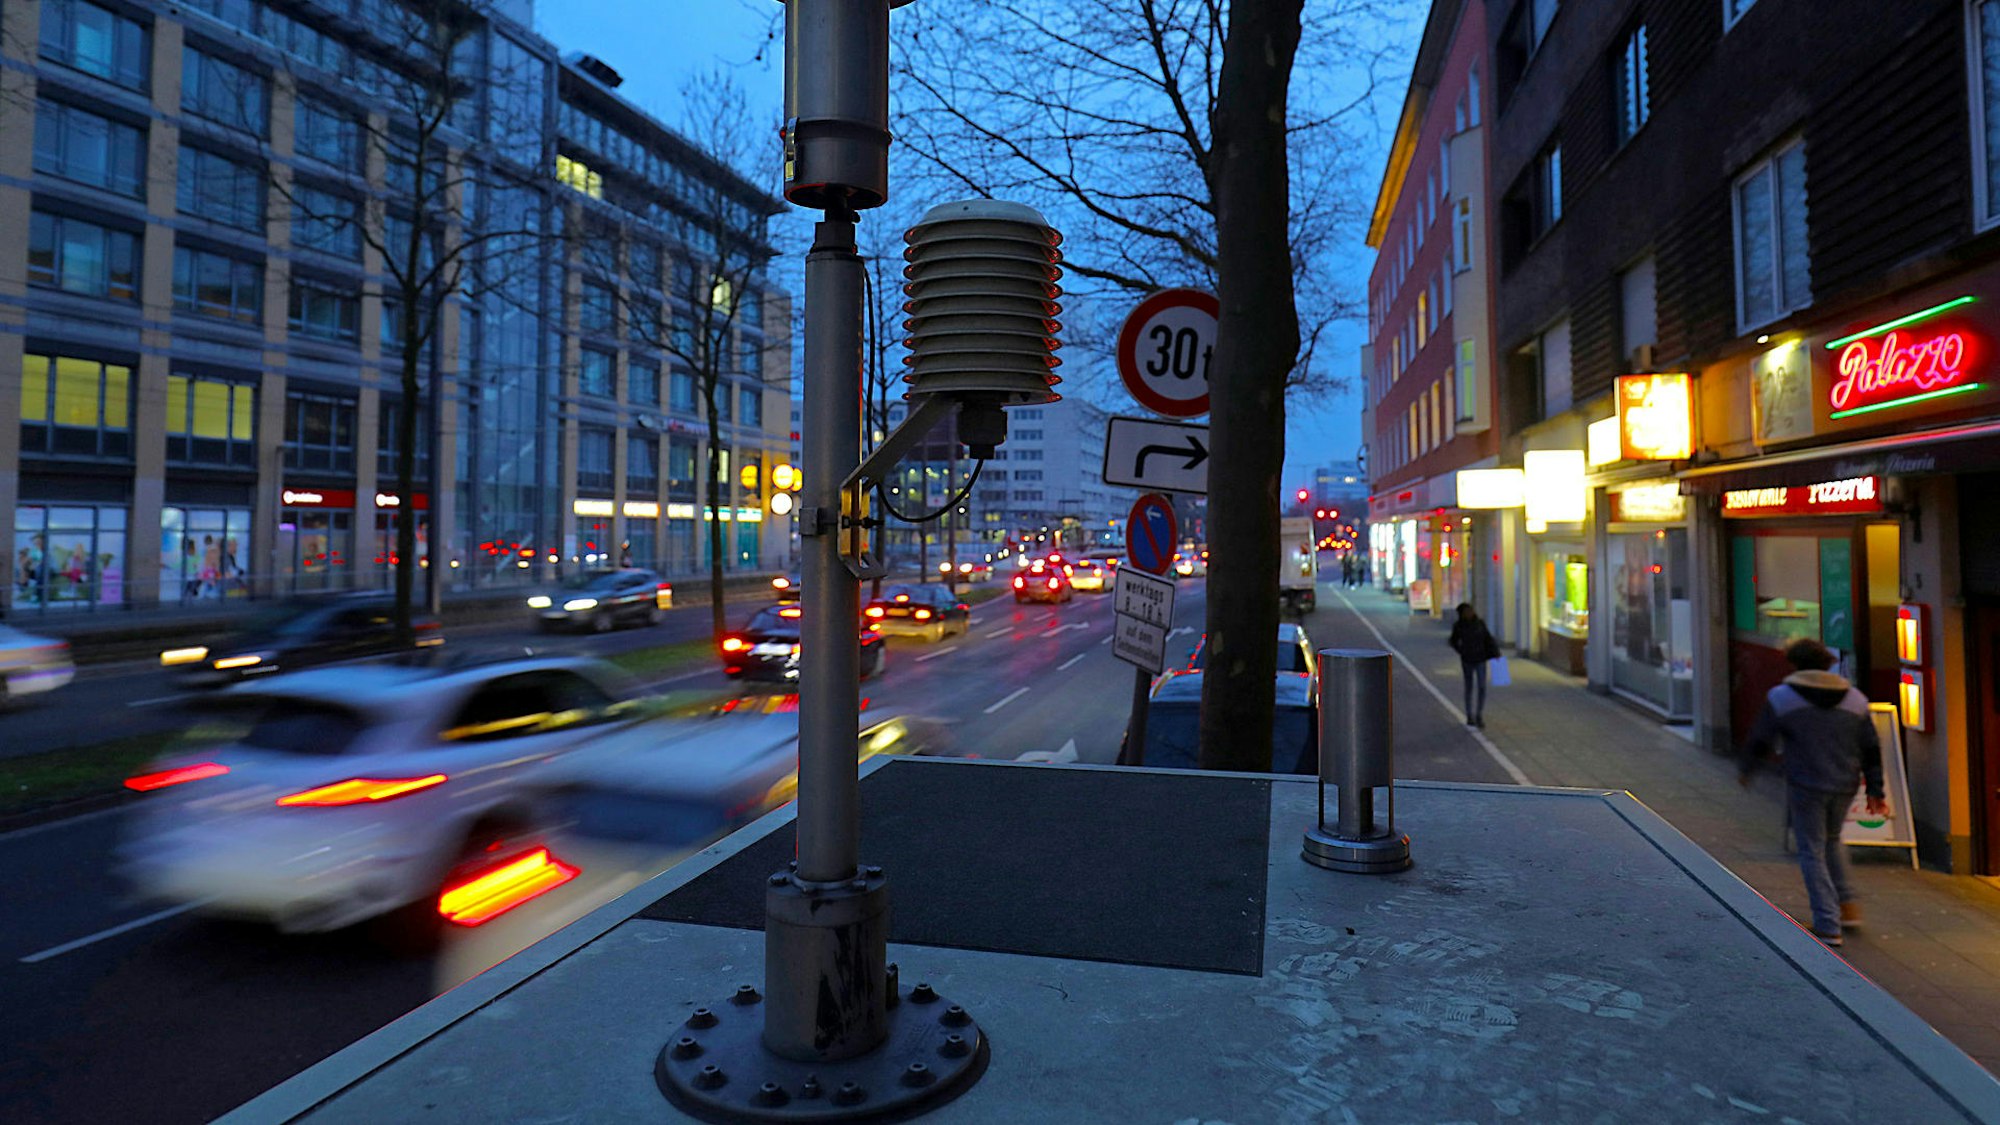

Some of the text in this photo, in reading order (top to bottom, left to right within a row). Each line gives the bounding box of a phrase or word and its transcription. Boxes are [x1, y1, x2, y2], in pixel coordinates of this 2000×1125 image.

[1147, 325, 1212, 380] 30 t
[1831, 333, 1963, 408] Palazzo
[1126, 581, 1164, 605] werktags
